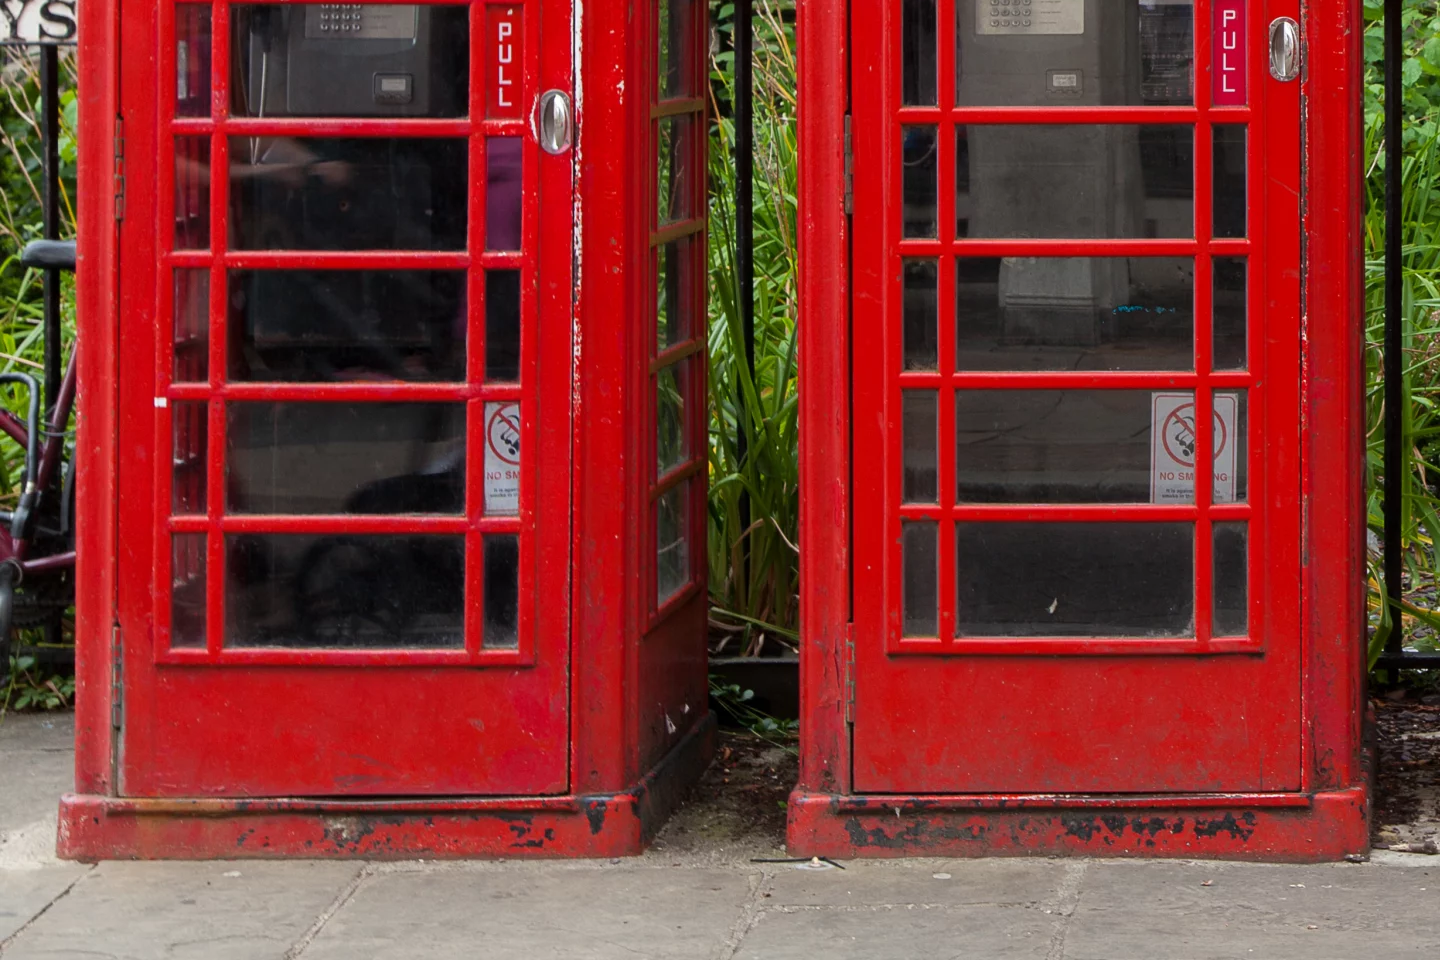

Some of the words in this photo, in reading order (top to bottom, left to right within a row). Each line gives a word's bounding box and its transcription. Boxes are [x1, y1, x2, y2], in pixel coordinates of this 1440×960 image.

[498, 22, 512, 107] PULL
[1223, 9, 1236, 93] PULL
[487, 472, 502, 480] NO
[1160, 472, 1175, 480] NO
[1178, 472, 1228, 482] SMNG
